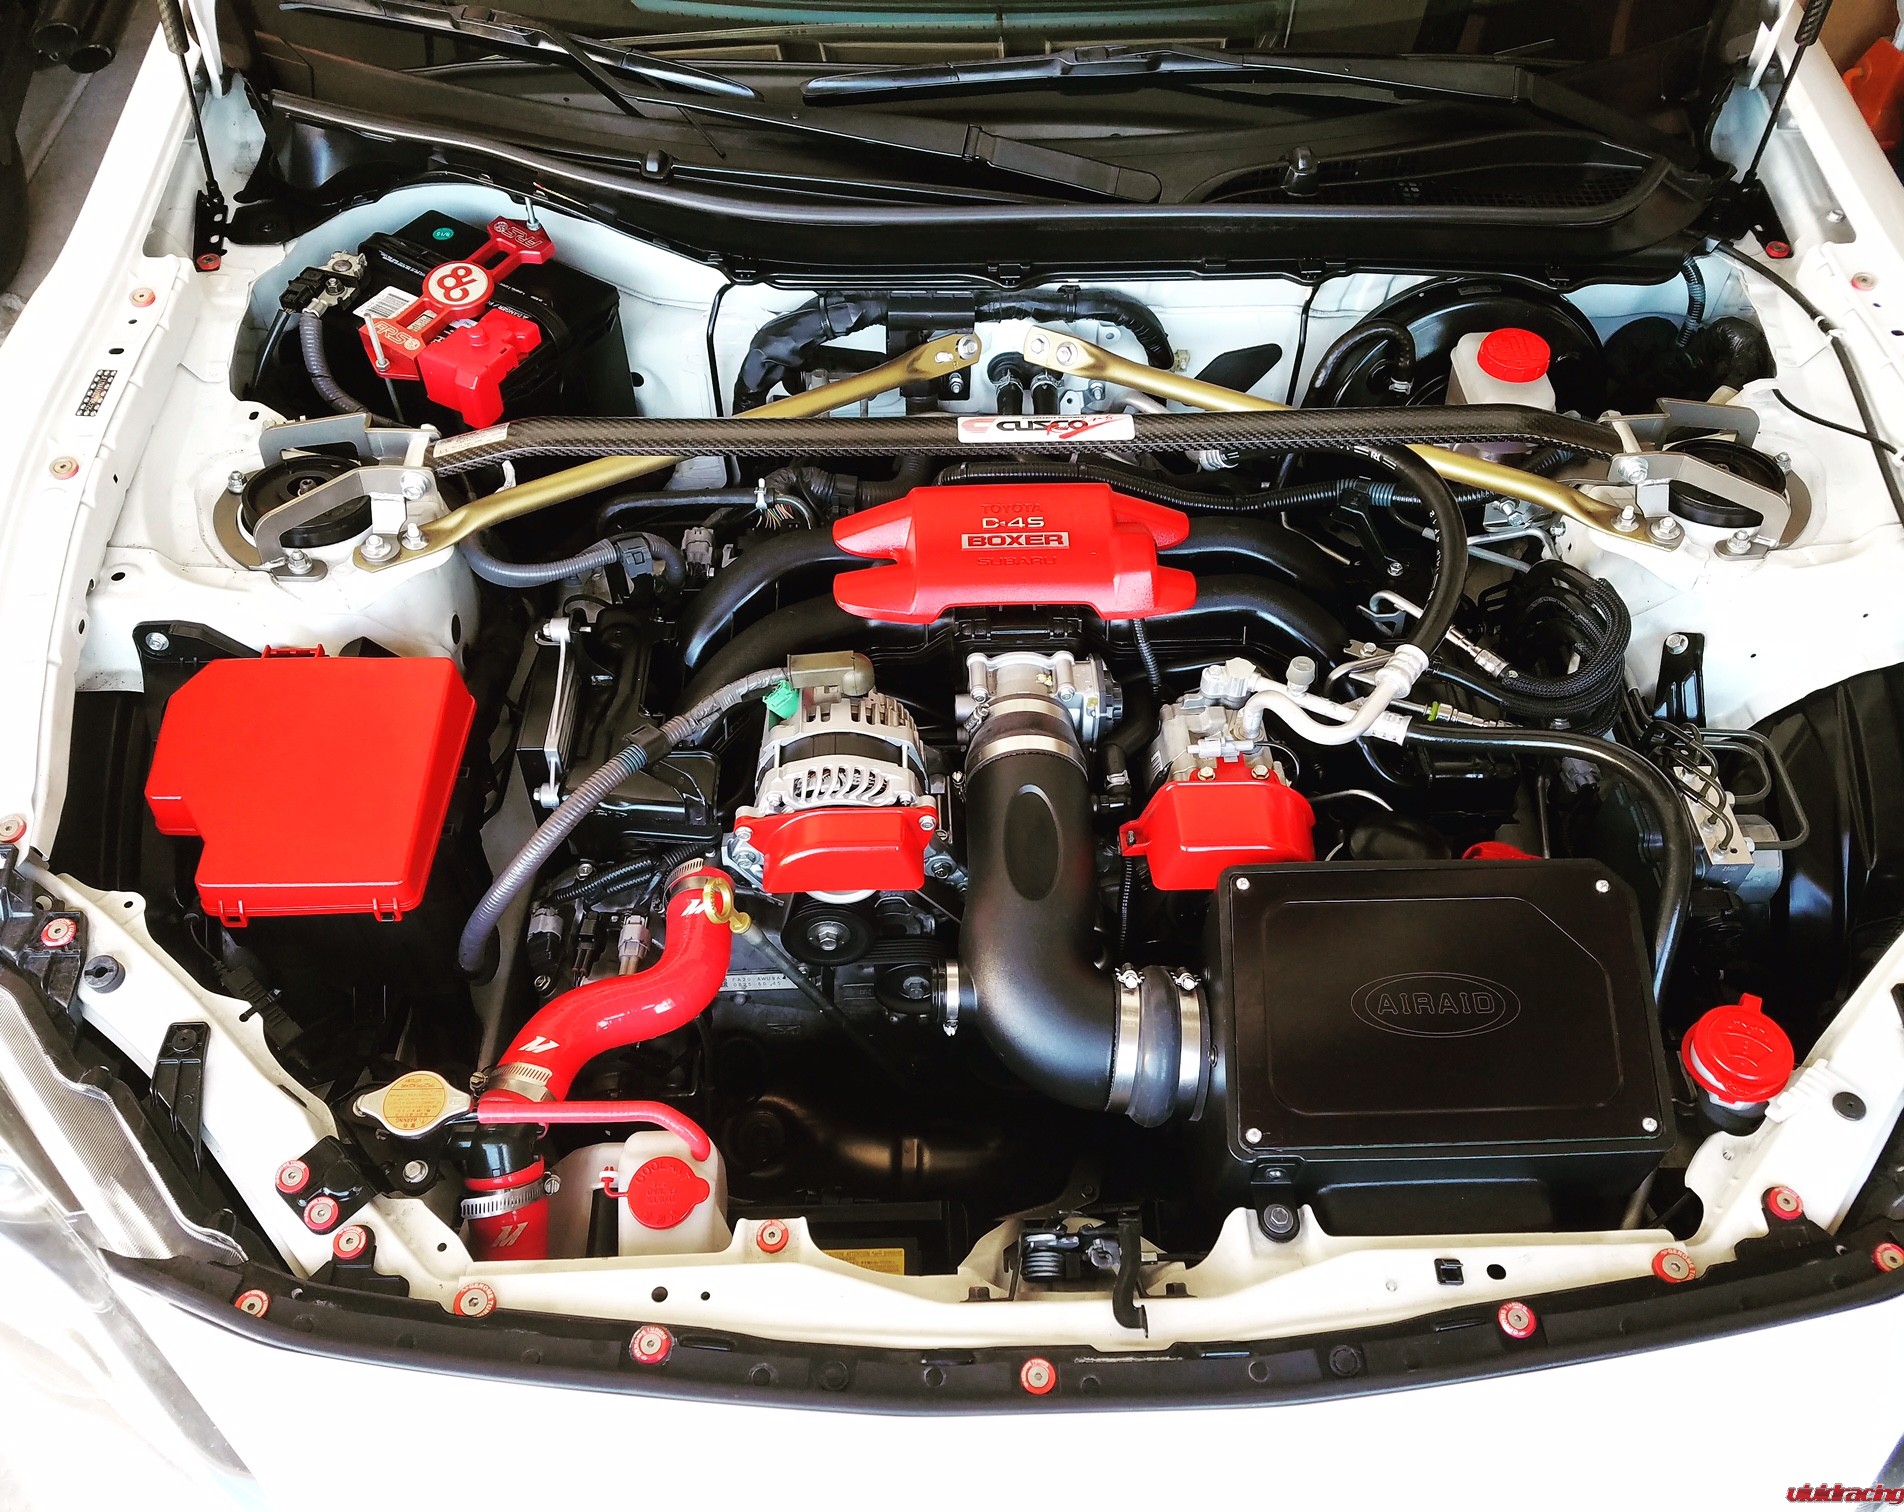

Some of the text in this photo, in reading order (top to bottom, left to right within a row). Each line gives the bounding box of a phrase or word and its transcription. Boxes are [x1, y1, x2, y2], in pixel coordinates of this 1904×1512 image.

[500, 226, 543, 249] FRS
[373, 320, 413, 345] FRS
[980, 502, 1044, 514] TOYOTA
[967, 533, 1065, 547] BOXER
[977, 555, 1057, 567] SUBARU
[1377, 991, 1495, 1015] AIRAID
